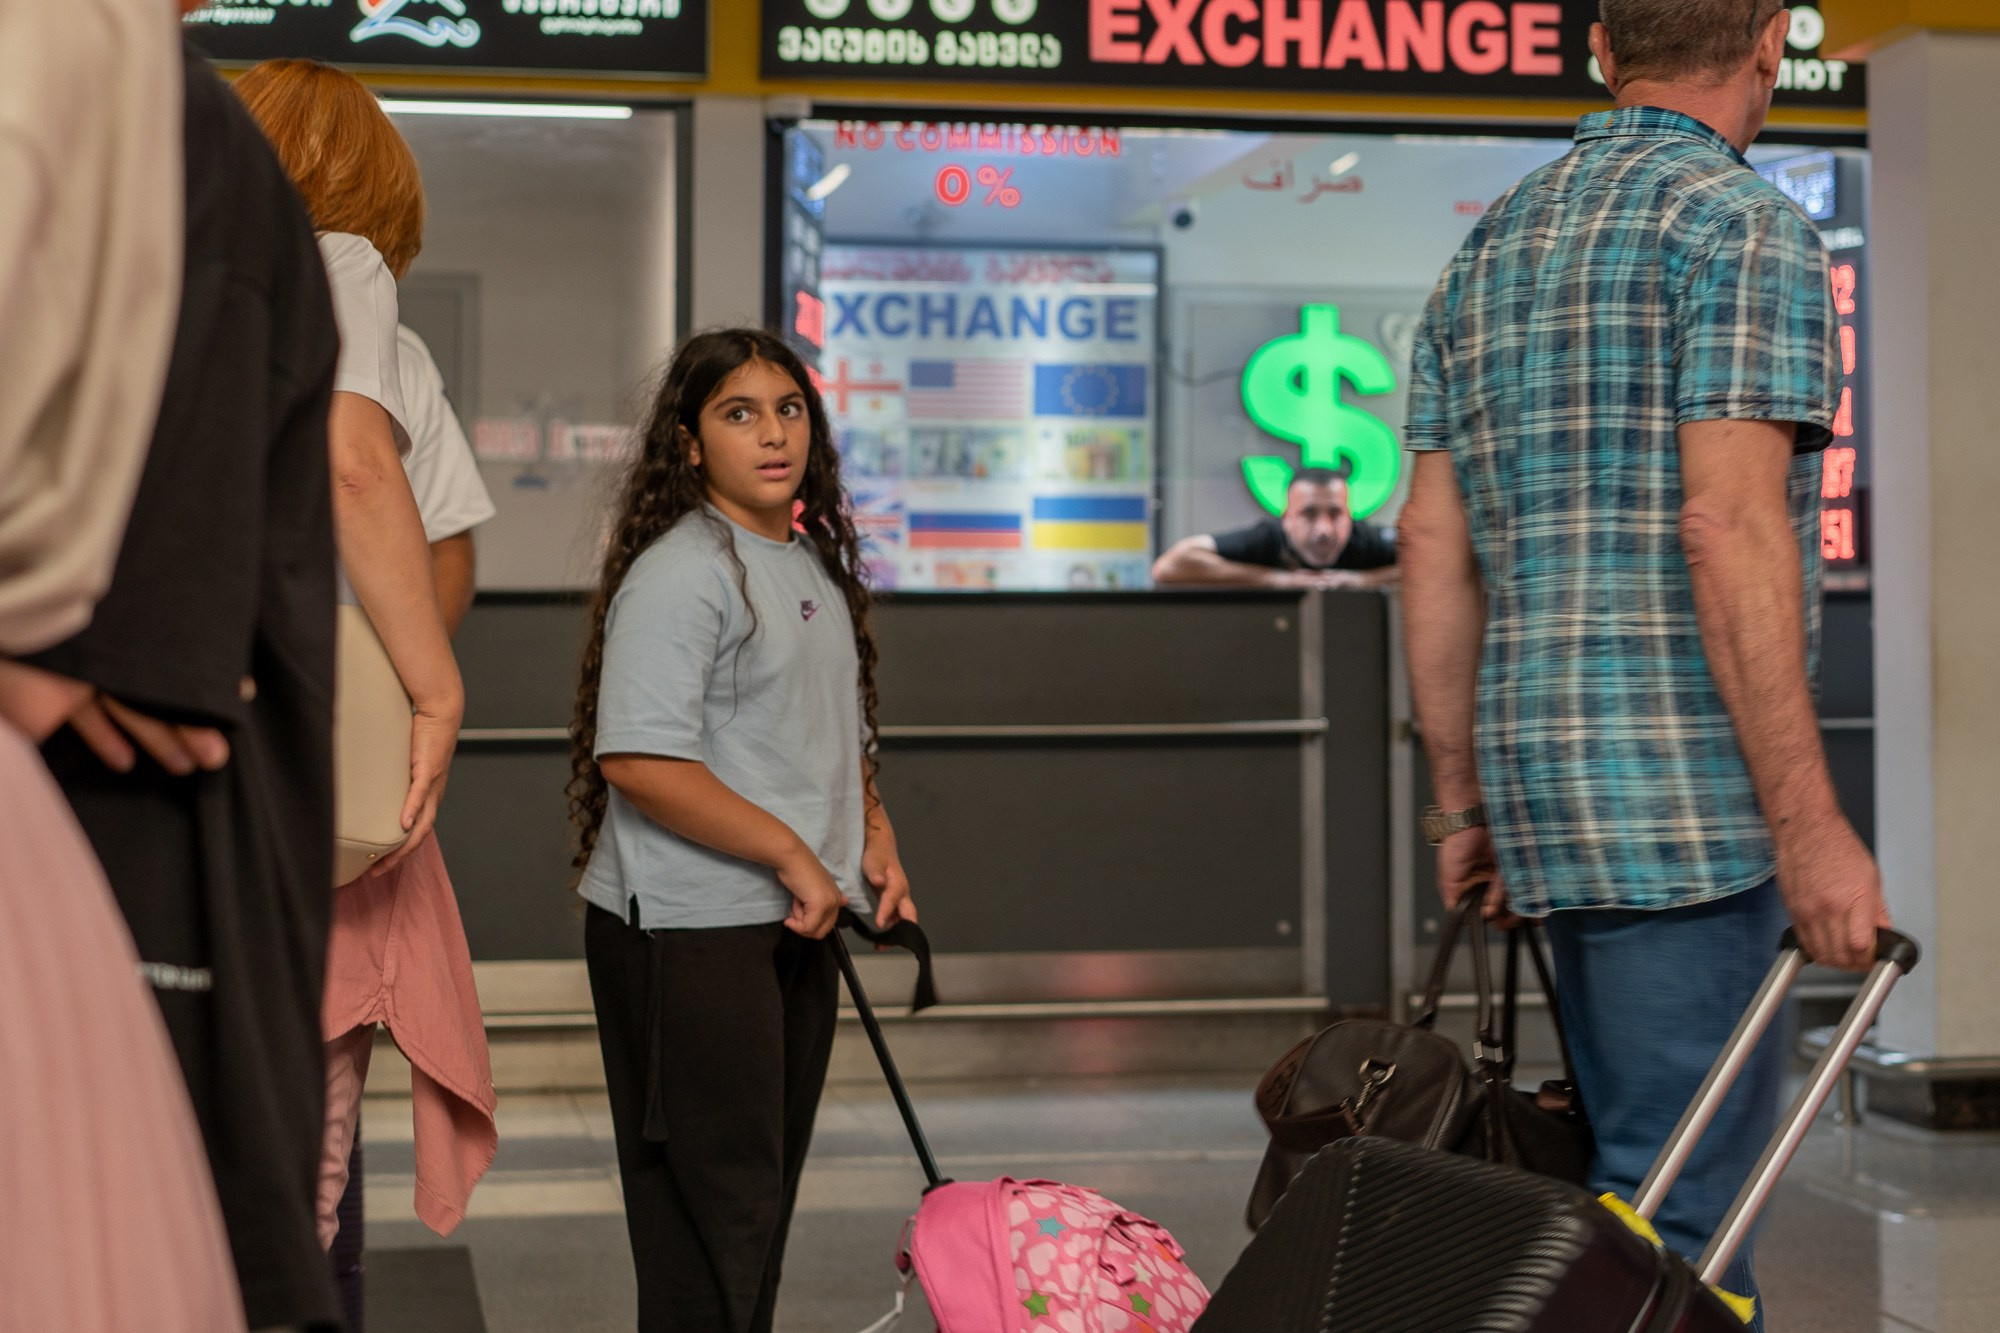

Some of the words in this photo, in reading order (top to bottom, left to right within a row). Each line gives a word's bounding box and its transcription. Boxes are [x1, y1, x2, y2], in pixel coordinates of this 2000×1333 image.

[1088, 0, 1563, 76] EXCHANGE
[1773, 57, 1848, 92] ЛЮТ
[833, 120, 886, 151] NO
[894, 120, 1121, 157] COMMISSION
[831, 291, 1138, 342] XCHANGE
